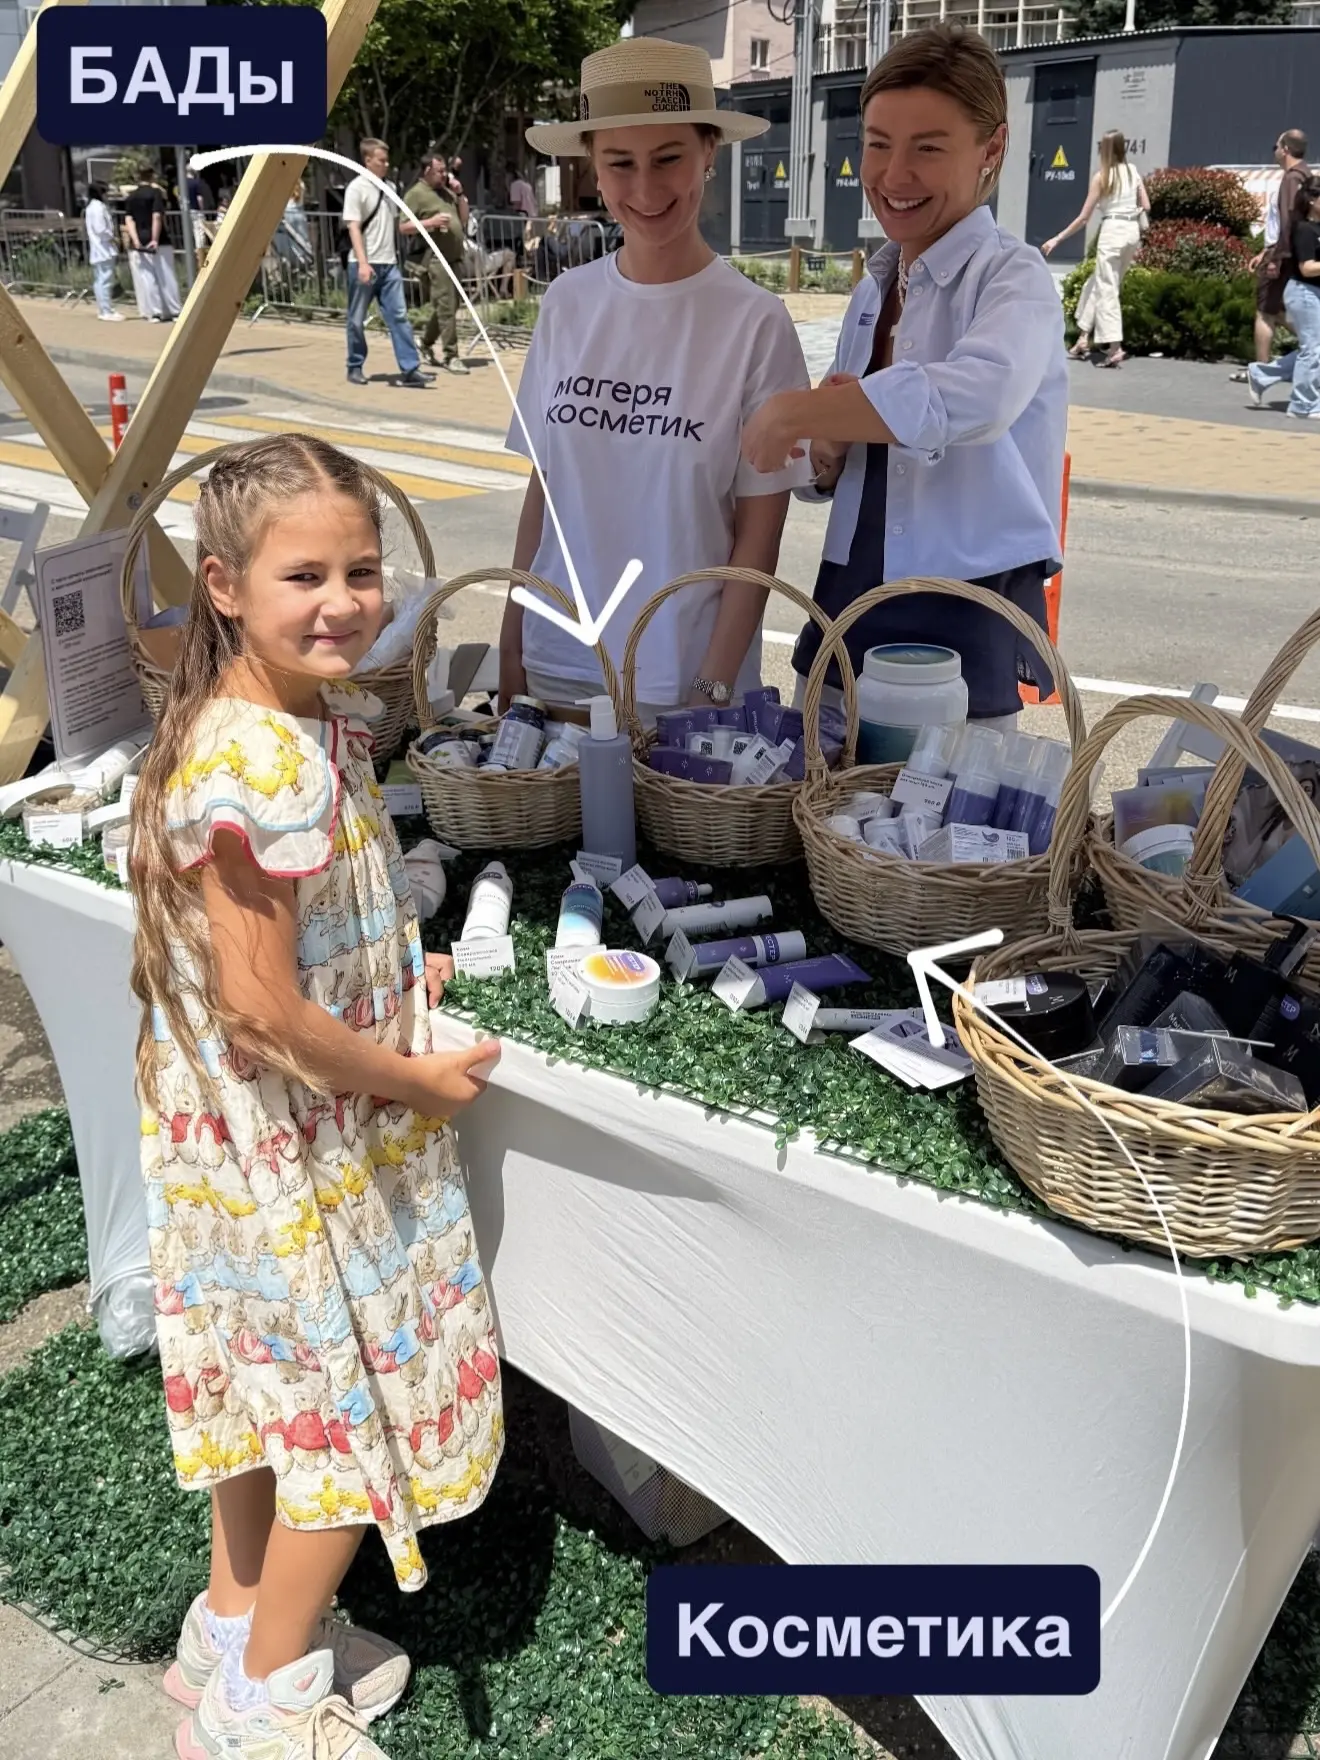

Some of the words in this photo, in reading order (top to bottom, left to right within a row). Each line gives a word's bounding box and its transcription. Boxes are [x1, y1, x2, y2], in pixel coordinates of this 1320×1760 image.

[554, 376, 672, 413] магеря
[546, 404, 704, 442] косметик
[765, 935, 776, 960] ЕСТЕР
